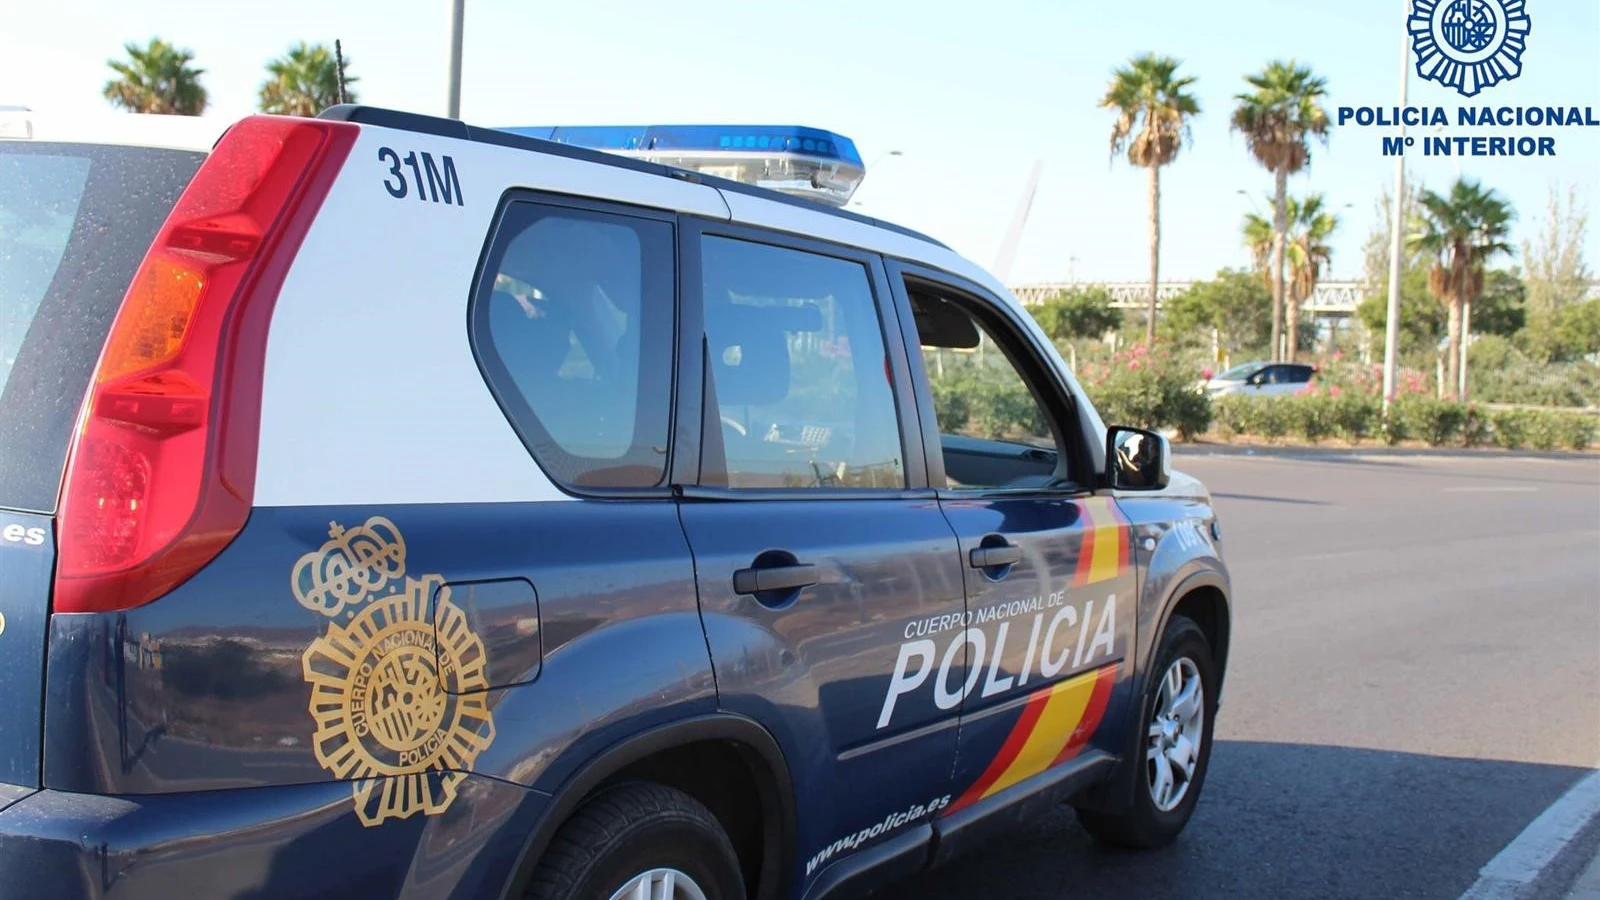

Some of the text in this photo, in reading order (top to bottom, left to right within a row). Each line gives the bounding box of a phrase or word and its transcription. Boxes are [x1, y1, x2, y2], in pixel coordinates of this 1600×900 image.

[378, 146, 464, 206] 31M
[904, 590, 1065, 639] CUERPO NACIONAL DE
[351, 662, 373, 738] CUERPO
[439, 651, 456, 676] DE
[876, 593, 1117, 730] POLICIA
[399, 728, 448, 767] POLICIA
[805, 794, 951, 876] www.policia.es
